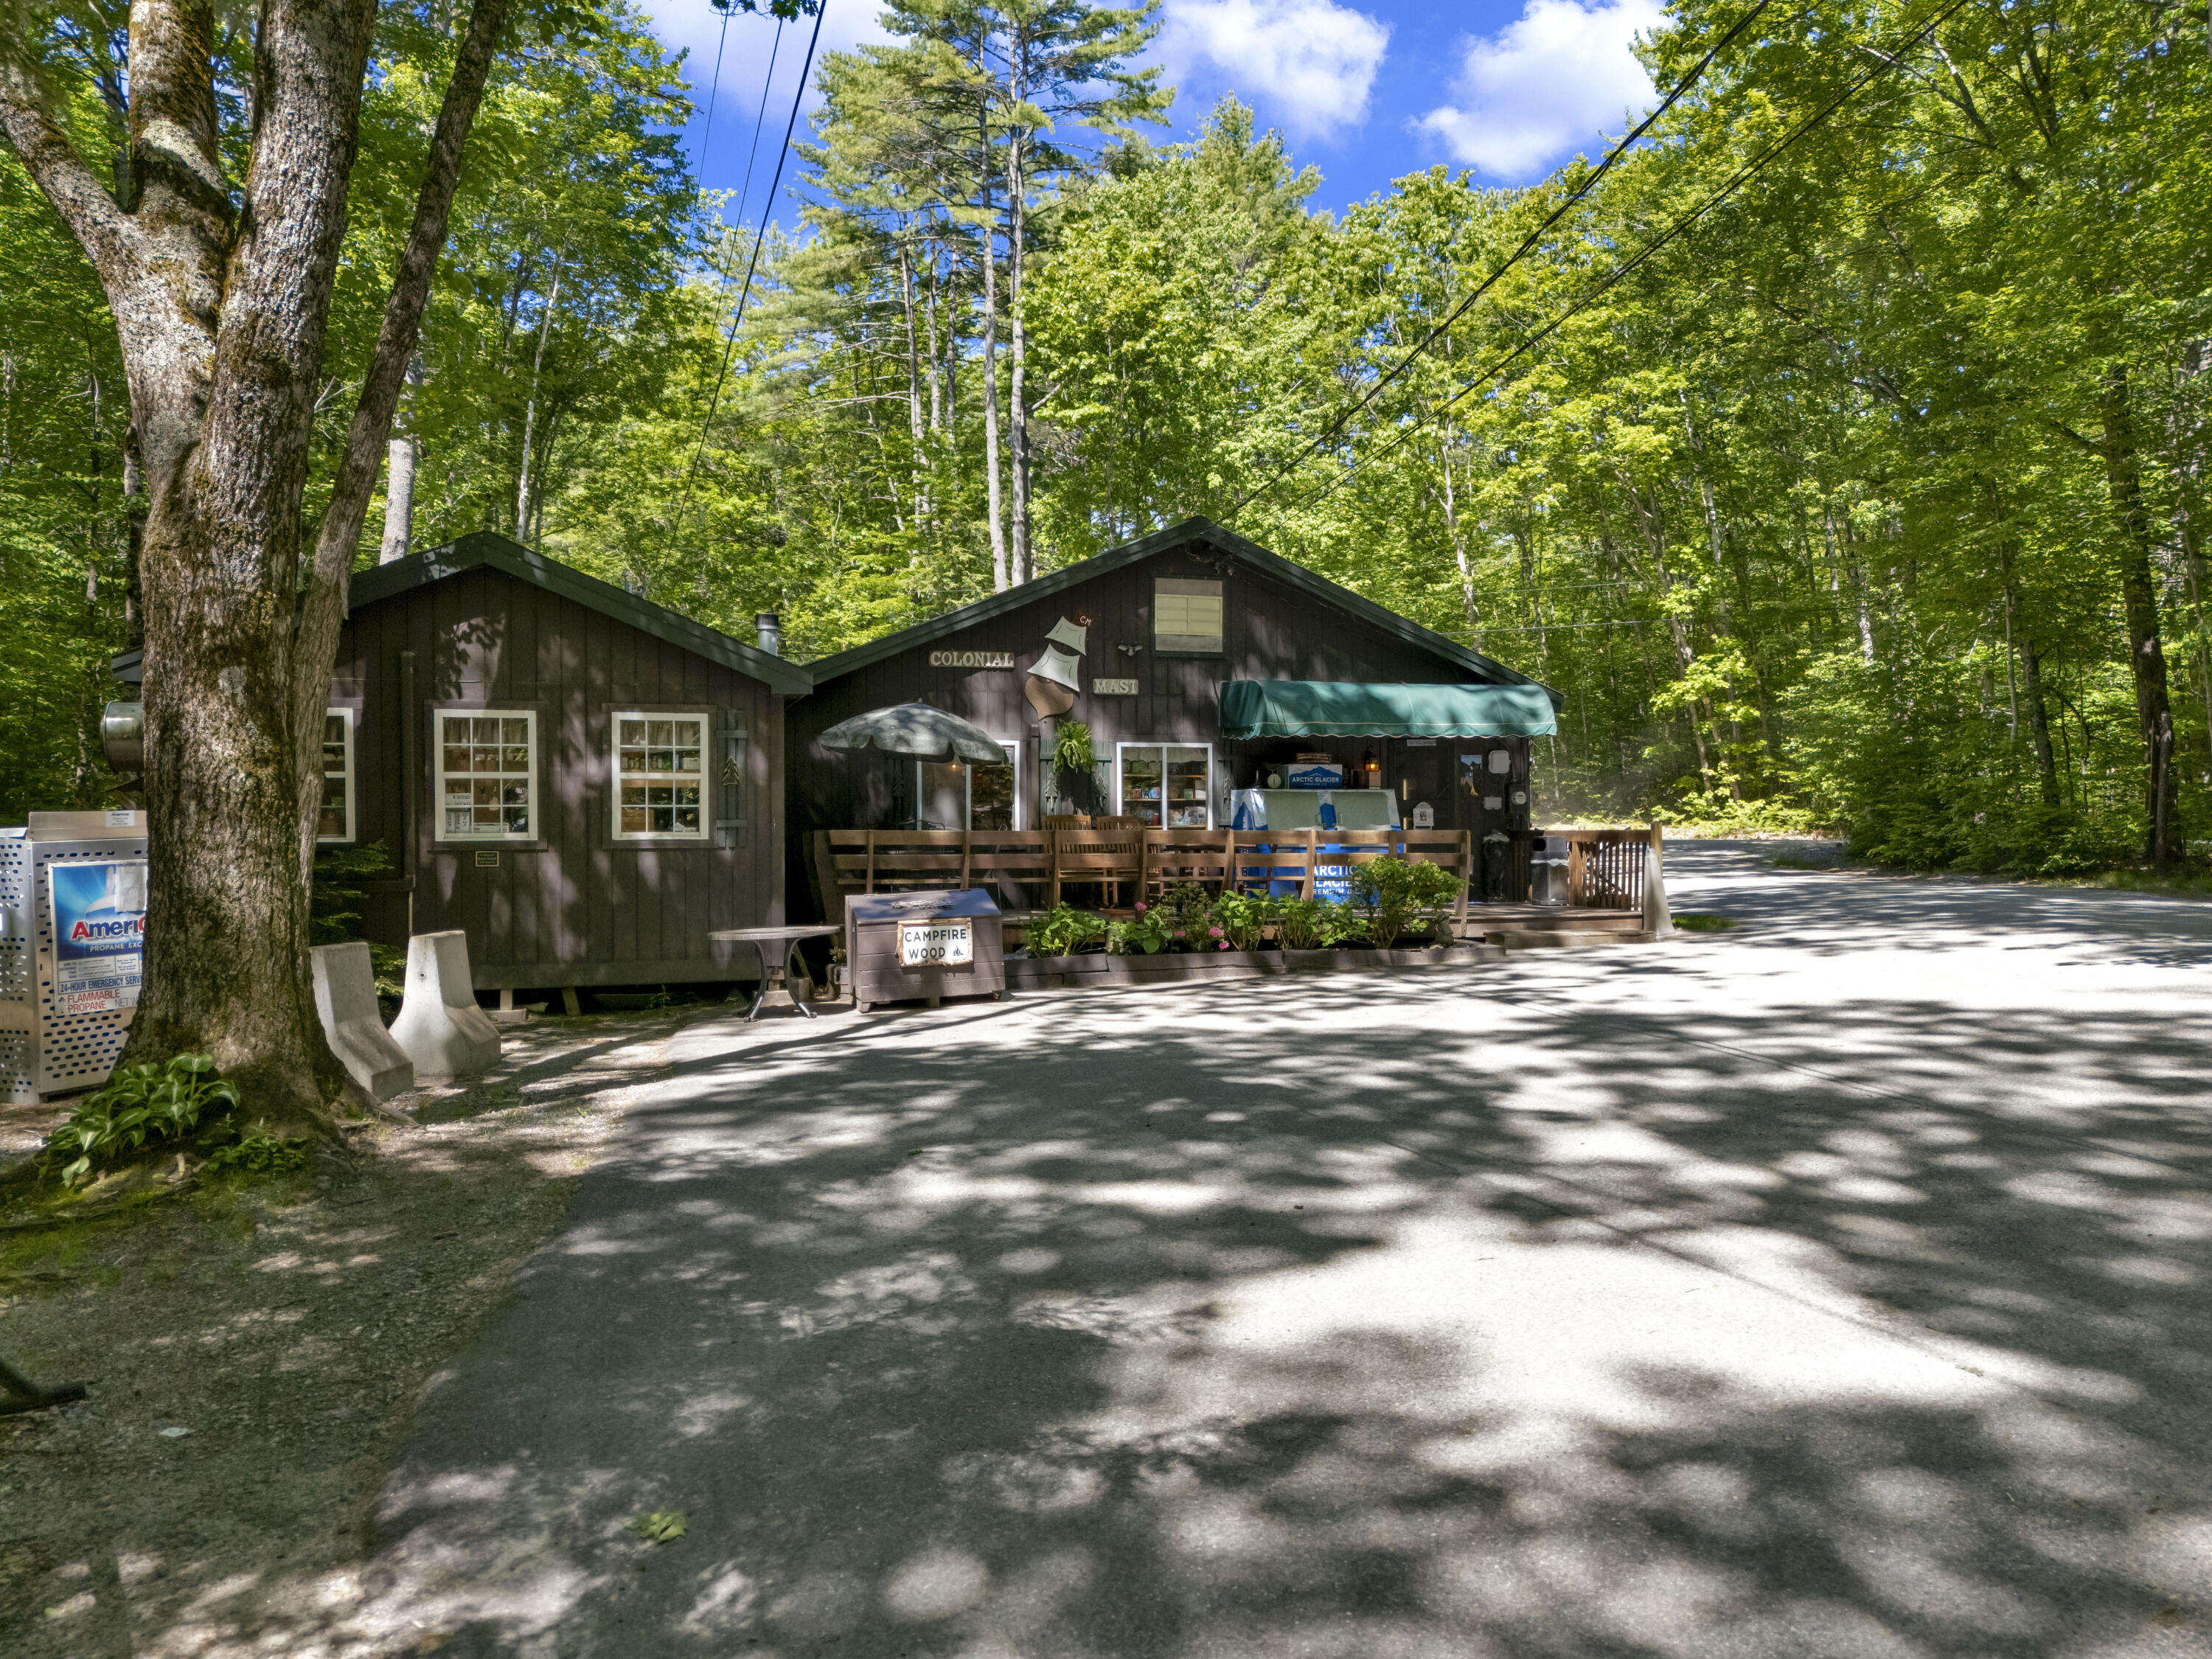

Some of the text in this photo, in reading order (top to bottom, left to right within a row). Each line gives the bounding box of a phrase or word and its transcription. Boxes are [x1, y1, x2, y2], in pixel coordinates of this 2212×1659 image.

[1079, 616, 1092, 626] CM
[930, 651, 1014, 667] COLONIAL
[1094, 679, 1136, 694] MAST
[905, 928, 967, 942] CAMPFIRE
[89, 943, 125, 953] PROPANE
[908, 947, 945, 959] WOOD
[60, 981, 87, 993] 24-HOUR
[88, 976, 125, 990] EMERGENCY
[66, 989, 121, 1004] FLAMMABLE
[66, 1000, 107, 1014] PROPANE
[114, 997, 129, 1008] NET
